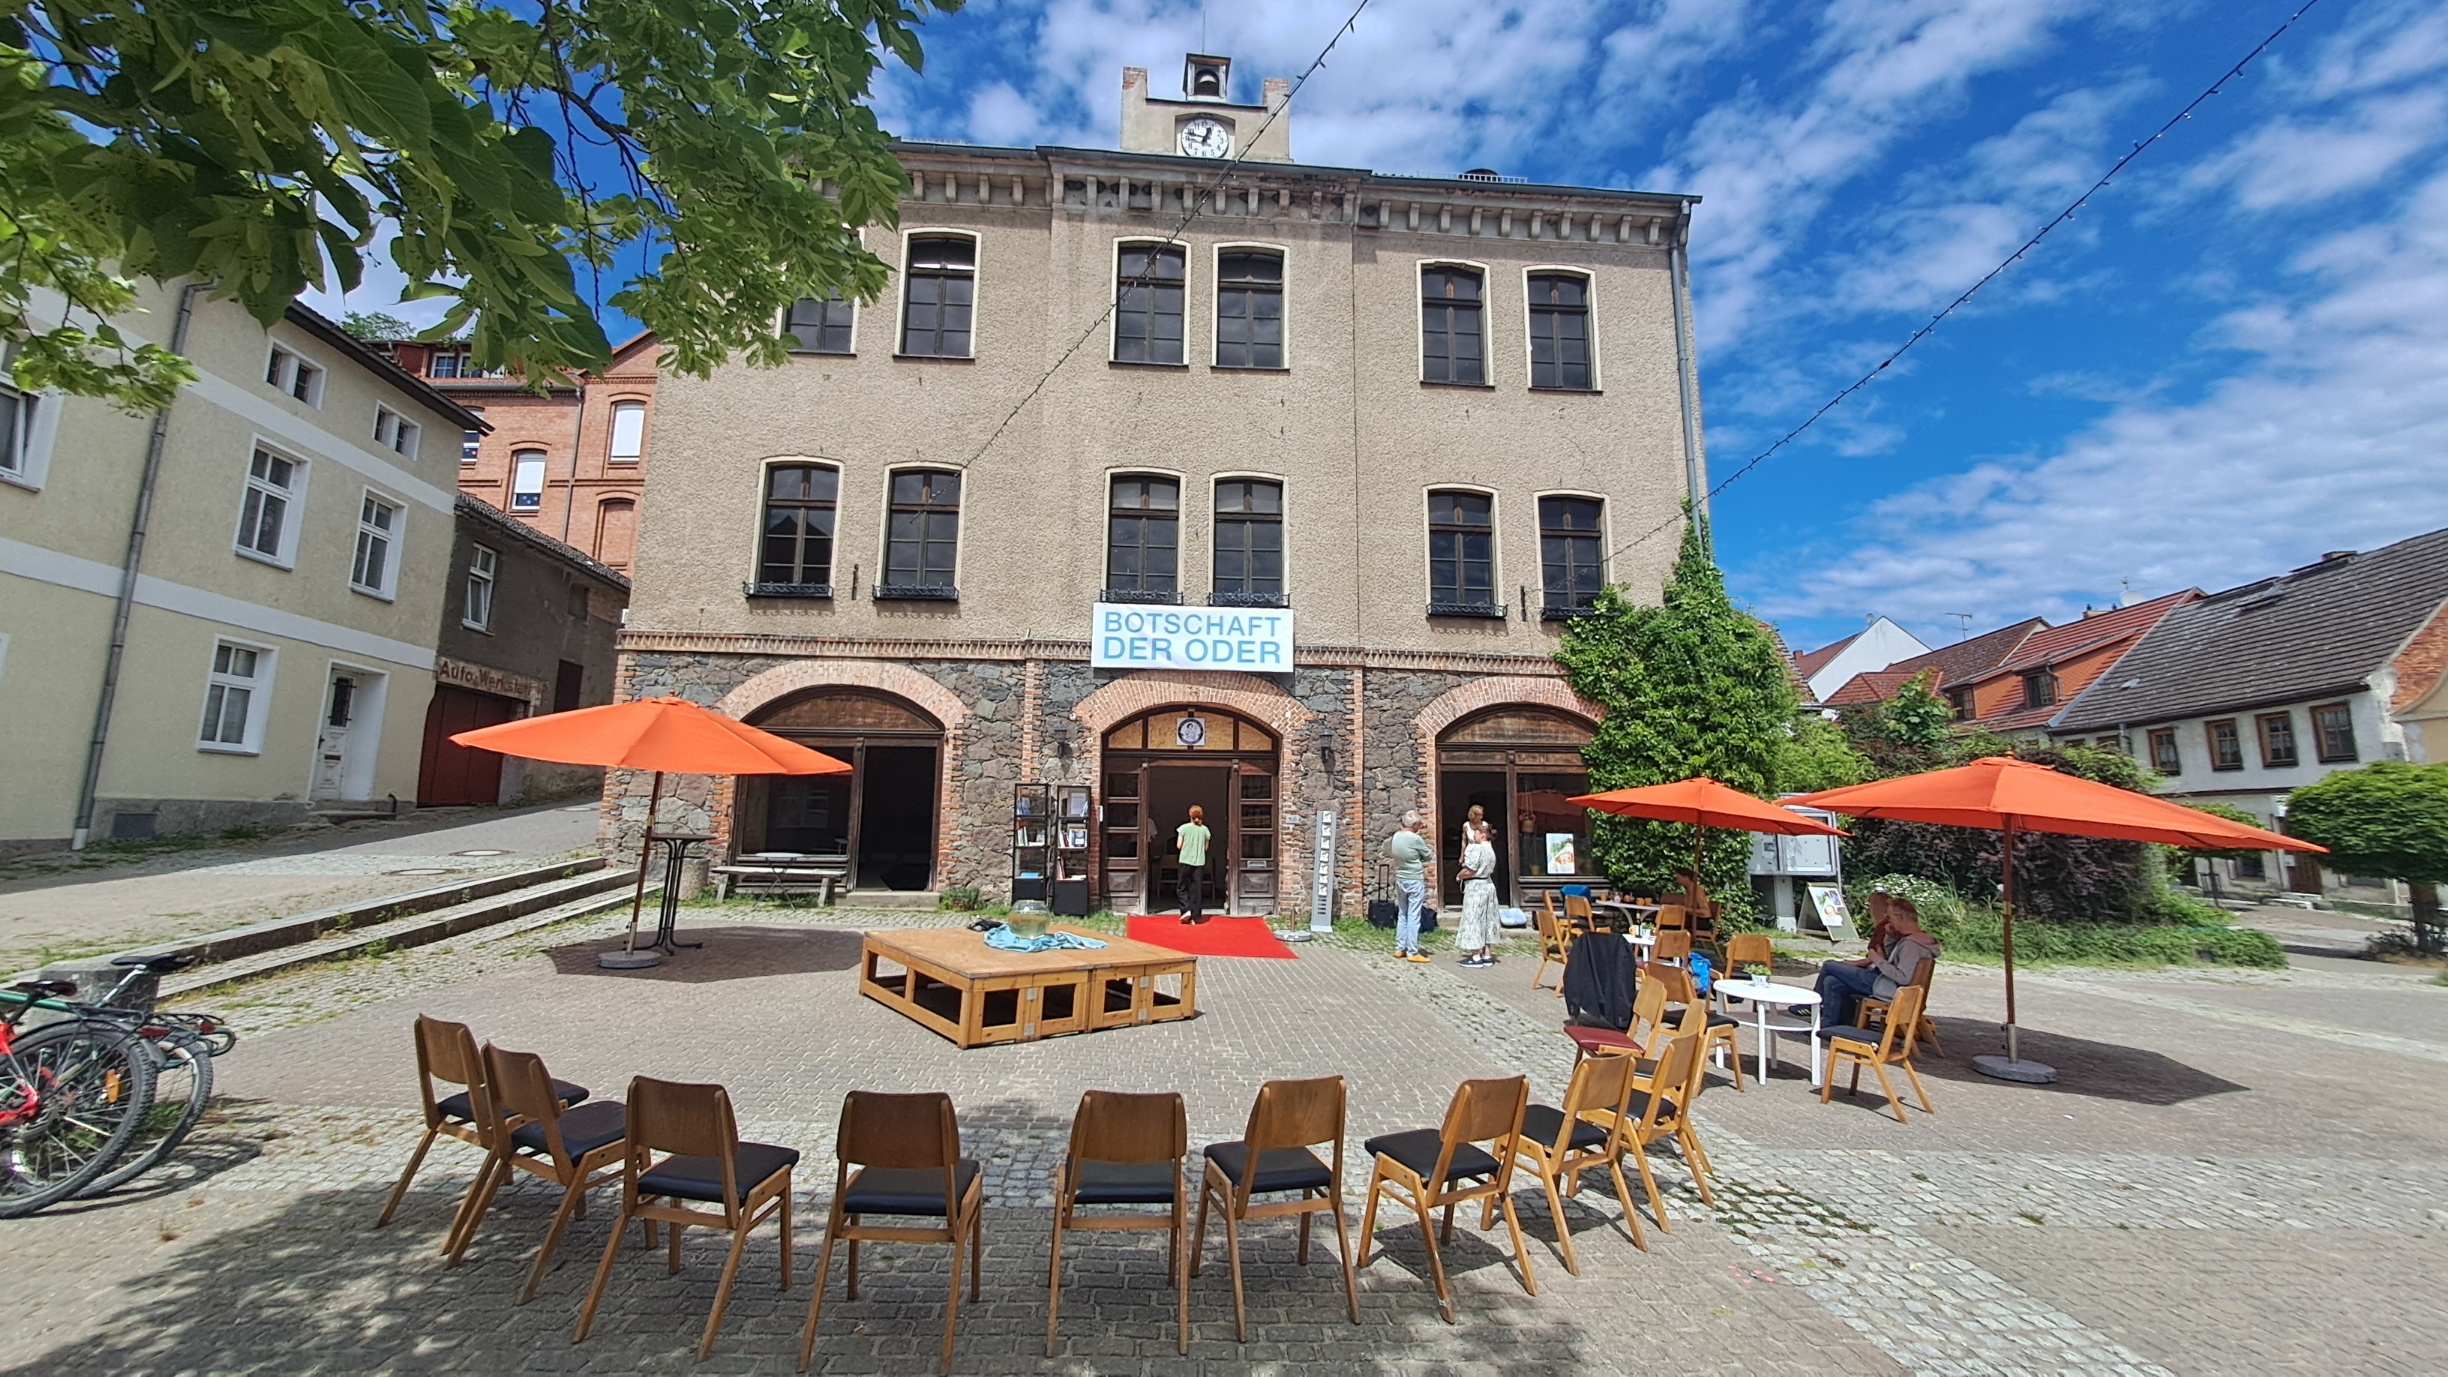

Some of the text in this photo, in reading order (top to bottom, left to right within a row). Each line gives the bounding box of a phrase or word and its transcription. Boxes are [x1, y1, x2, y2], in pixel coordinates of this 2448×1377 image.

[1104, 612, 1281, 637] BOTSCHAFT
[1103, 637, 1281, 664] DER ODER
[439, 660, 531, 696] Auto-Werksta
